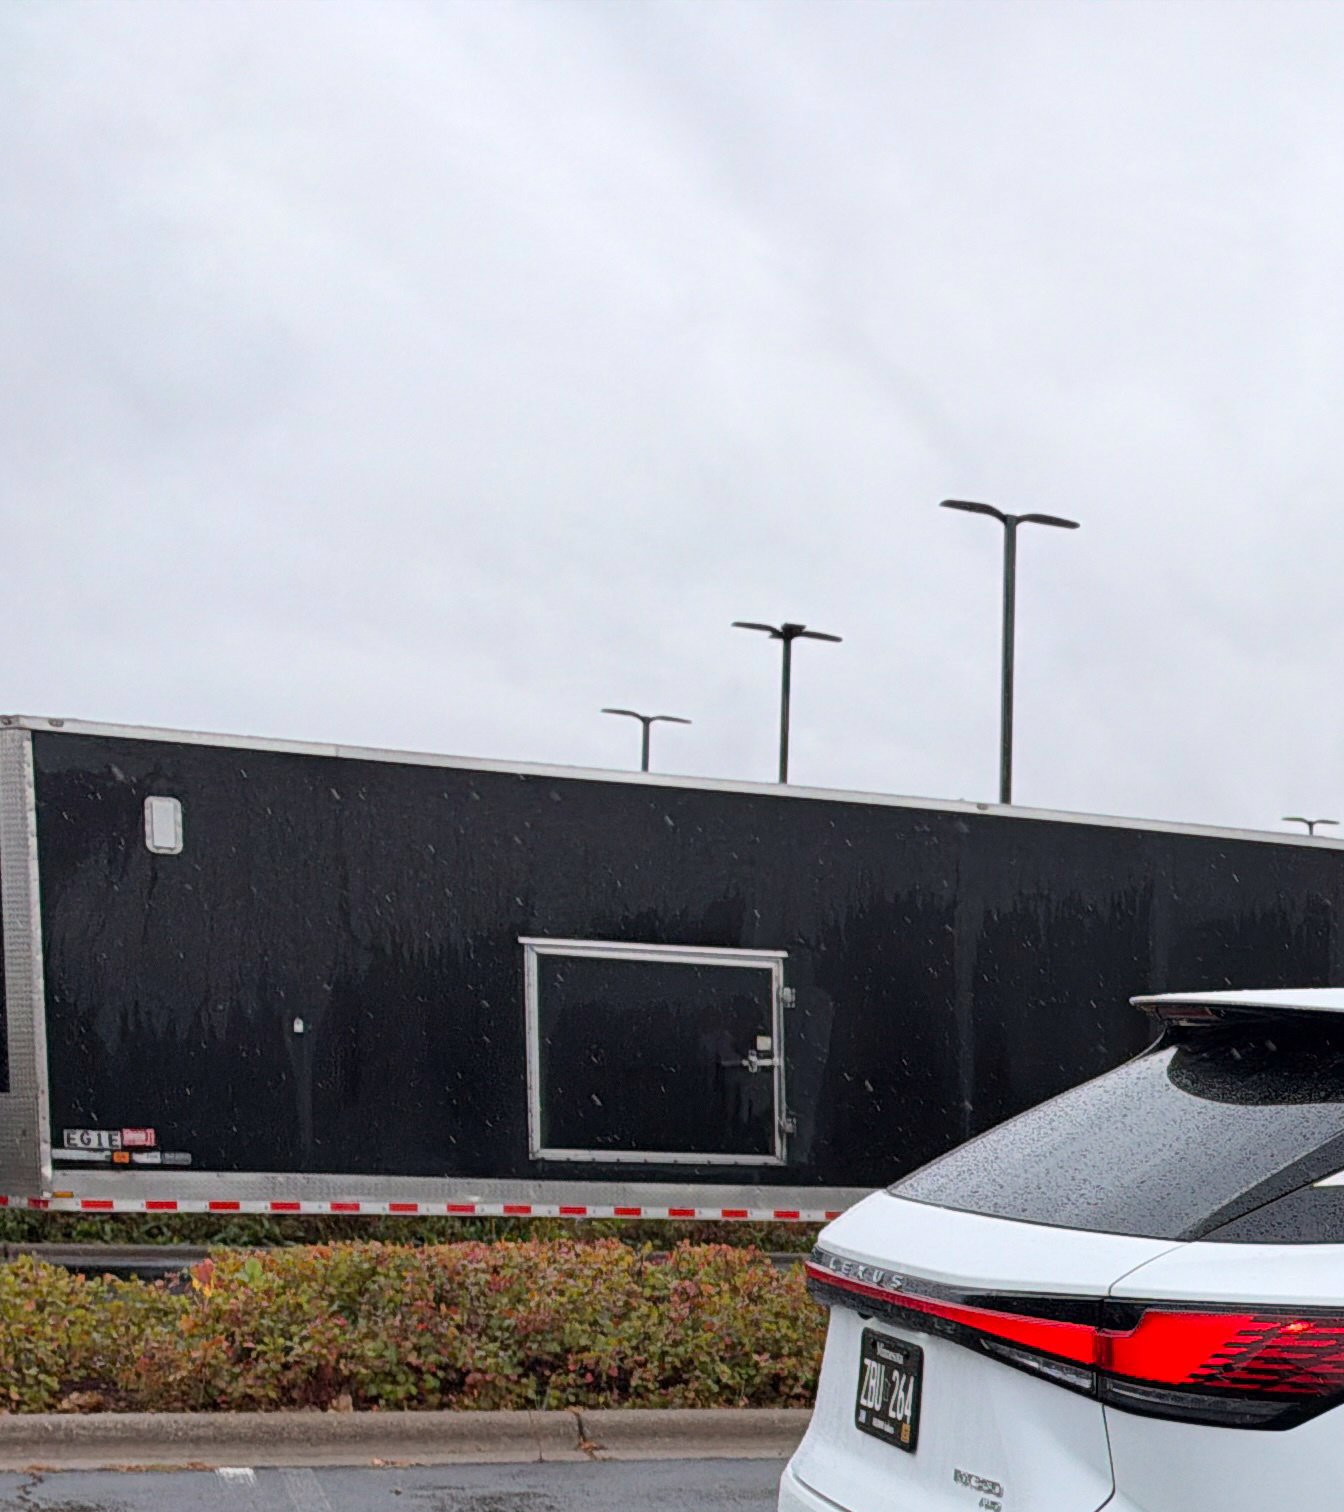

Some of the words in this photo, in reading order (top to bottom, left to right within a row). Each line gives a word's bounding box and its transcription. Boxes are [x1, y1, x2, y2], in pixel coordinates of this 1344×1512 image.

[828, 1257, 905, 1291] LEXUS
[860, 1358, 886, 1412] ZBU
[888, 1368, 914, 1425] 264
